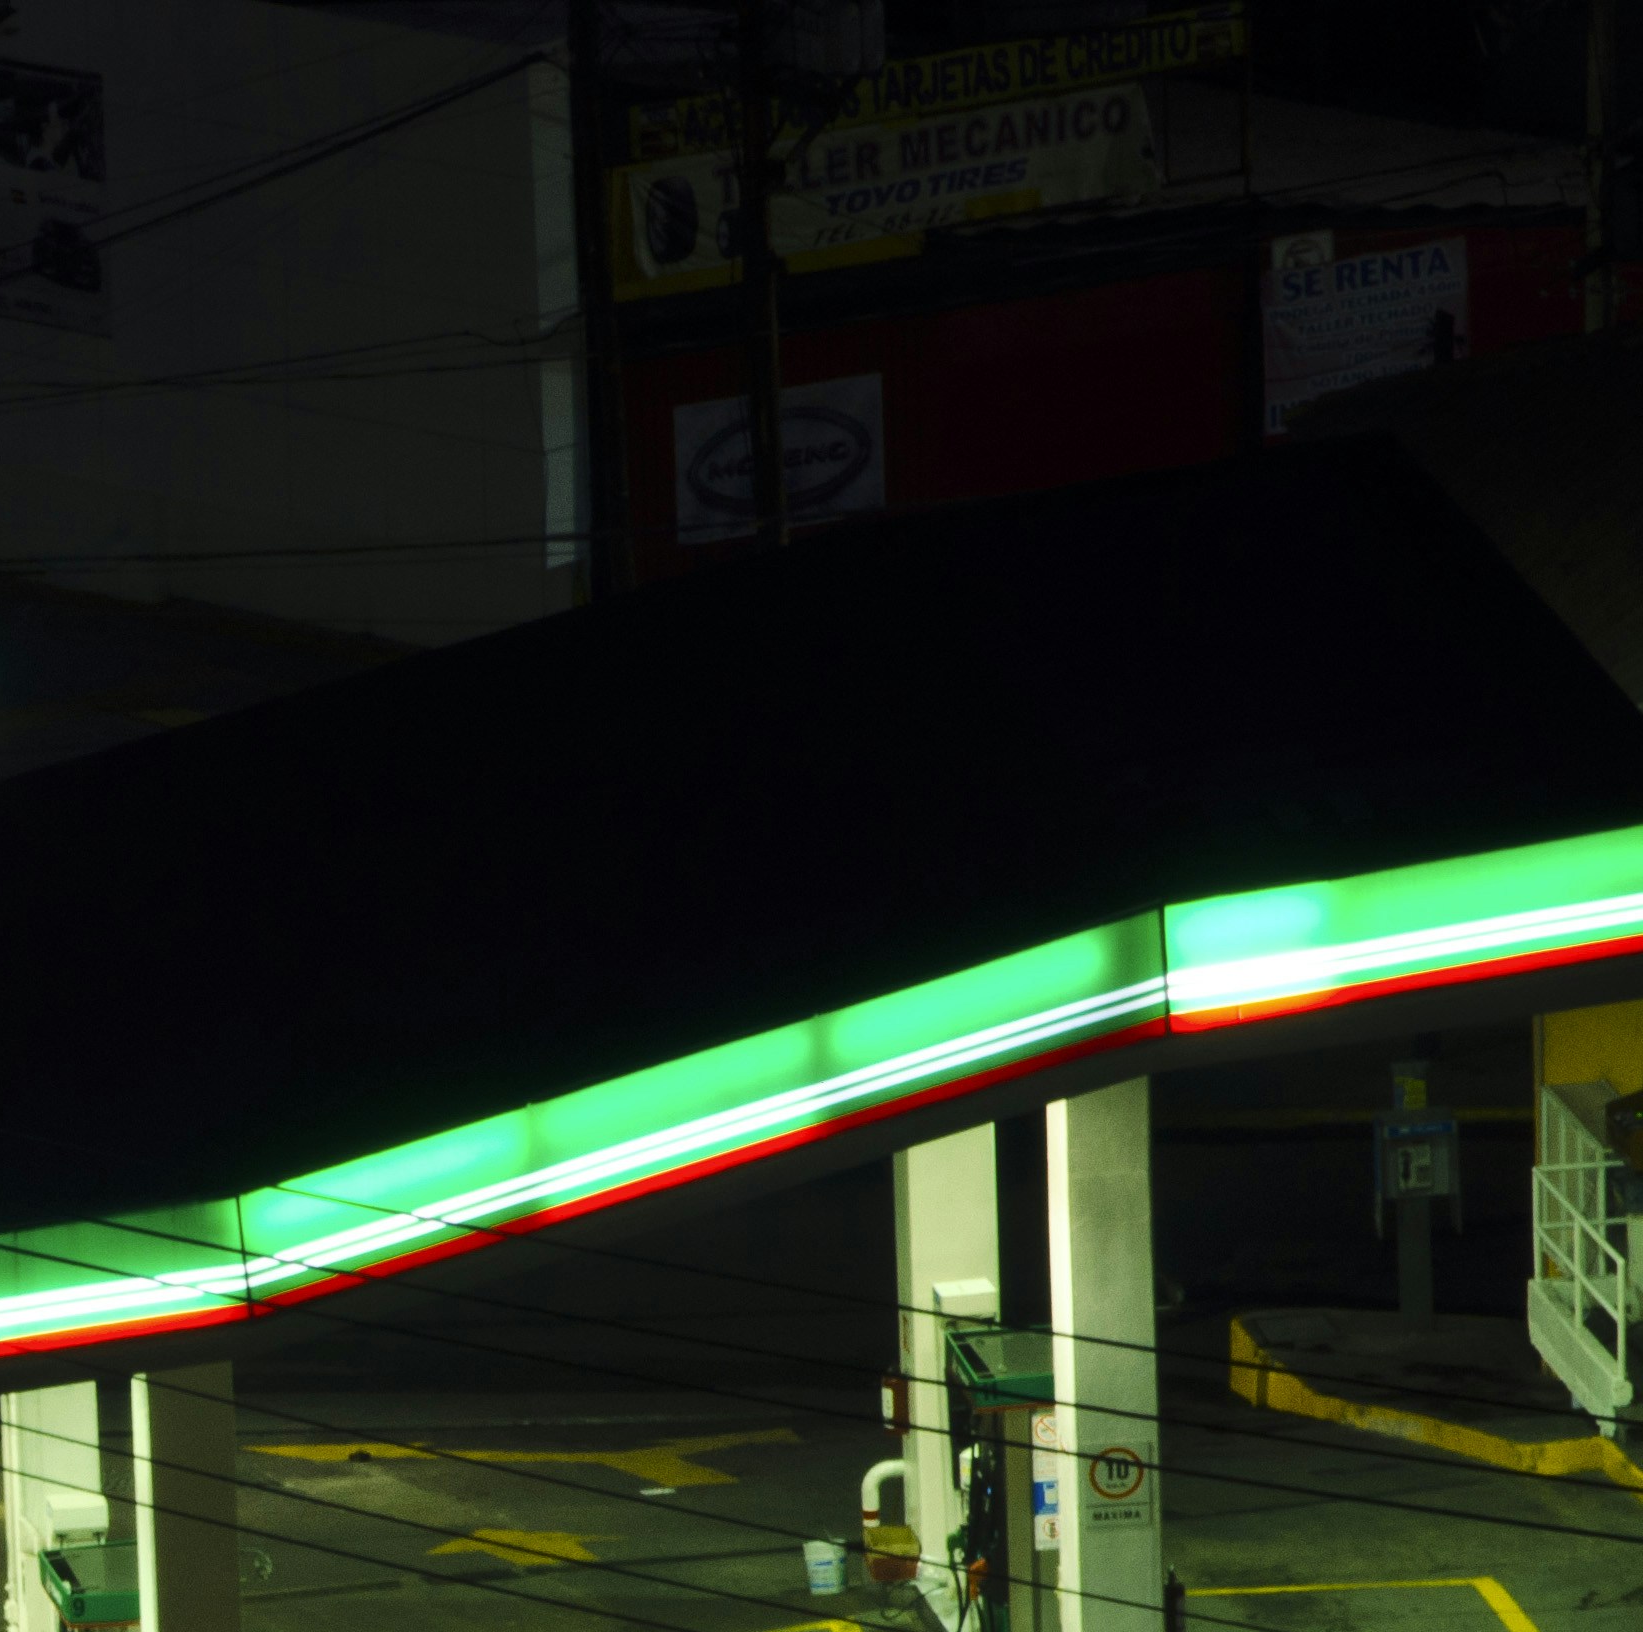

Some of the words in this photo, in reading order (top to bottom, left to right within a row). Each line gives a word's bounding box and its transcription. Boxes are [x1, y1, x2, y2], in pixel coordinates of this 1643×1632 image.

[871, 50, 1010, 114] TARJETAS
[1019, 38, 1056, 87] DE
[902, 96, 1132, 172] MECANICO
[825, 179, 923, 217] TOYO
[929, 159, 1028, 199] TIRES
[1282, 268, 1324, 301] SE
[1335, 247, 1450, 292] RENTA
[1106, 1458, 1130, 1481] 10
